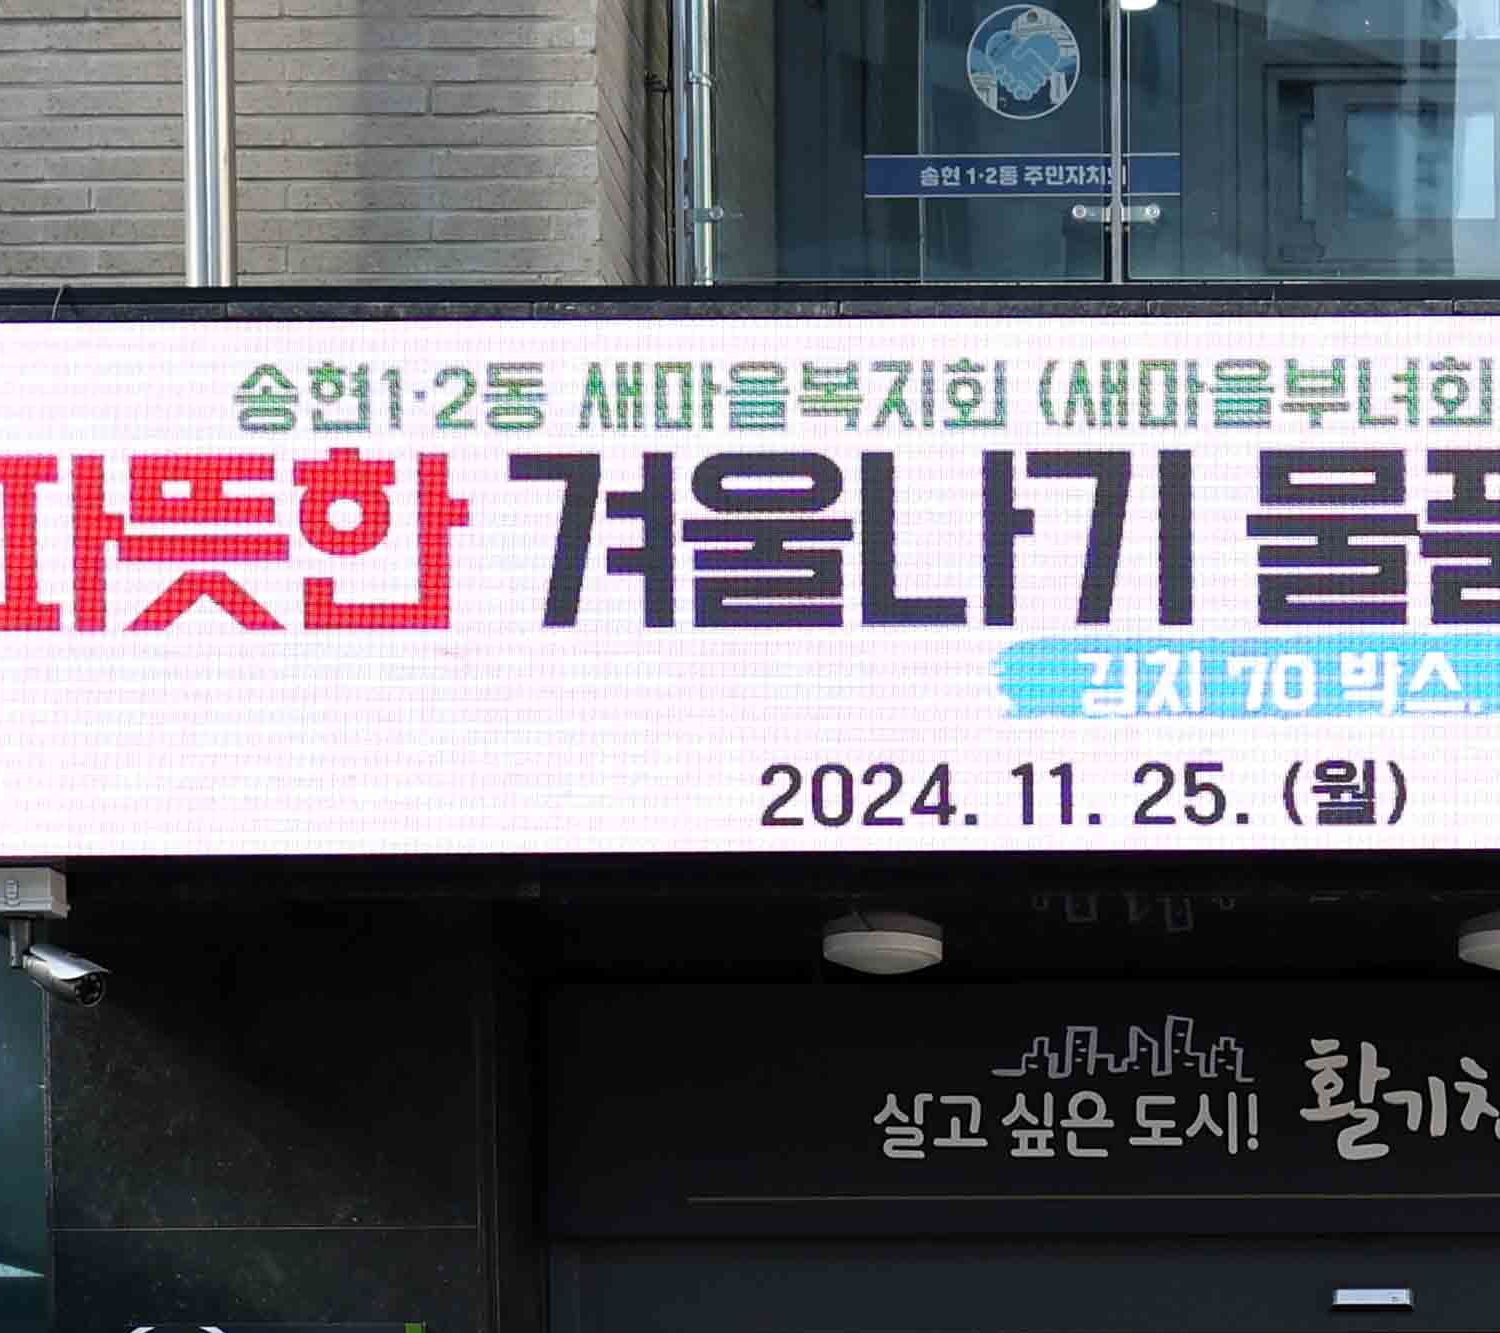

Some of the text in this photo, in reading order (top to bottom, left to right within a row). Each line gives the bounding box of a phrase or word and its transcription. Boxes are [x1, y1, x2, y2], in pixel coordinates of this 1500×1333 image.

[919, 165, 961, 187] 송현
[581, 357, 1006, 434] 새마을복지회
[1039, 356, 1494, 434] (새마을부녀회
[508, 449, 1193, 628] 겨울나기
[1080, 649, 1204, 718] 김치
[1226, 654, 1313, 715] 70
[760, 756, 1410, 829] 2024. 11. 25. (월)
[873, 1089, 985, 1159] 살고
[1007, 1090, 1117, 1159] 싶은
[1129, 1087, 1261, 1159] 도시!
